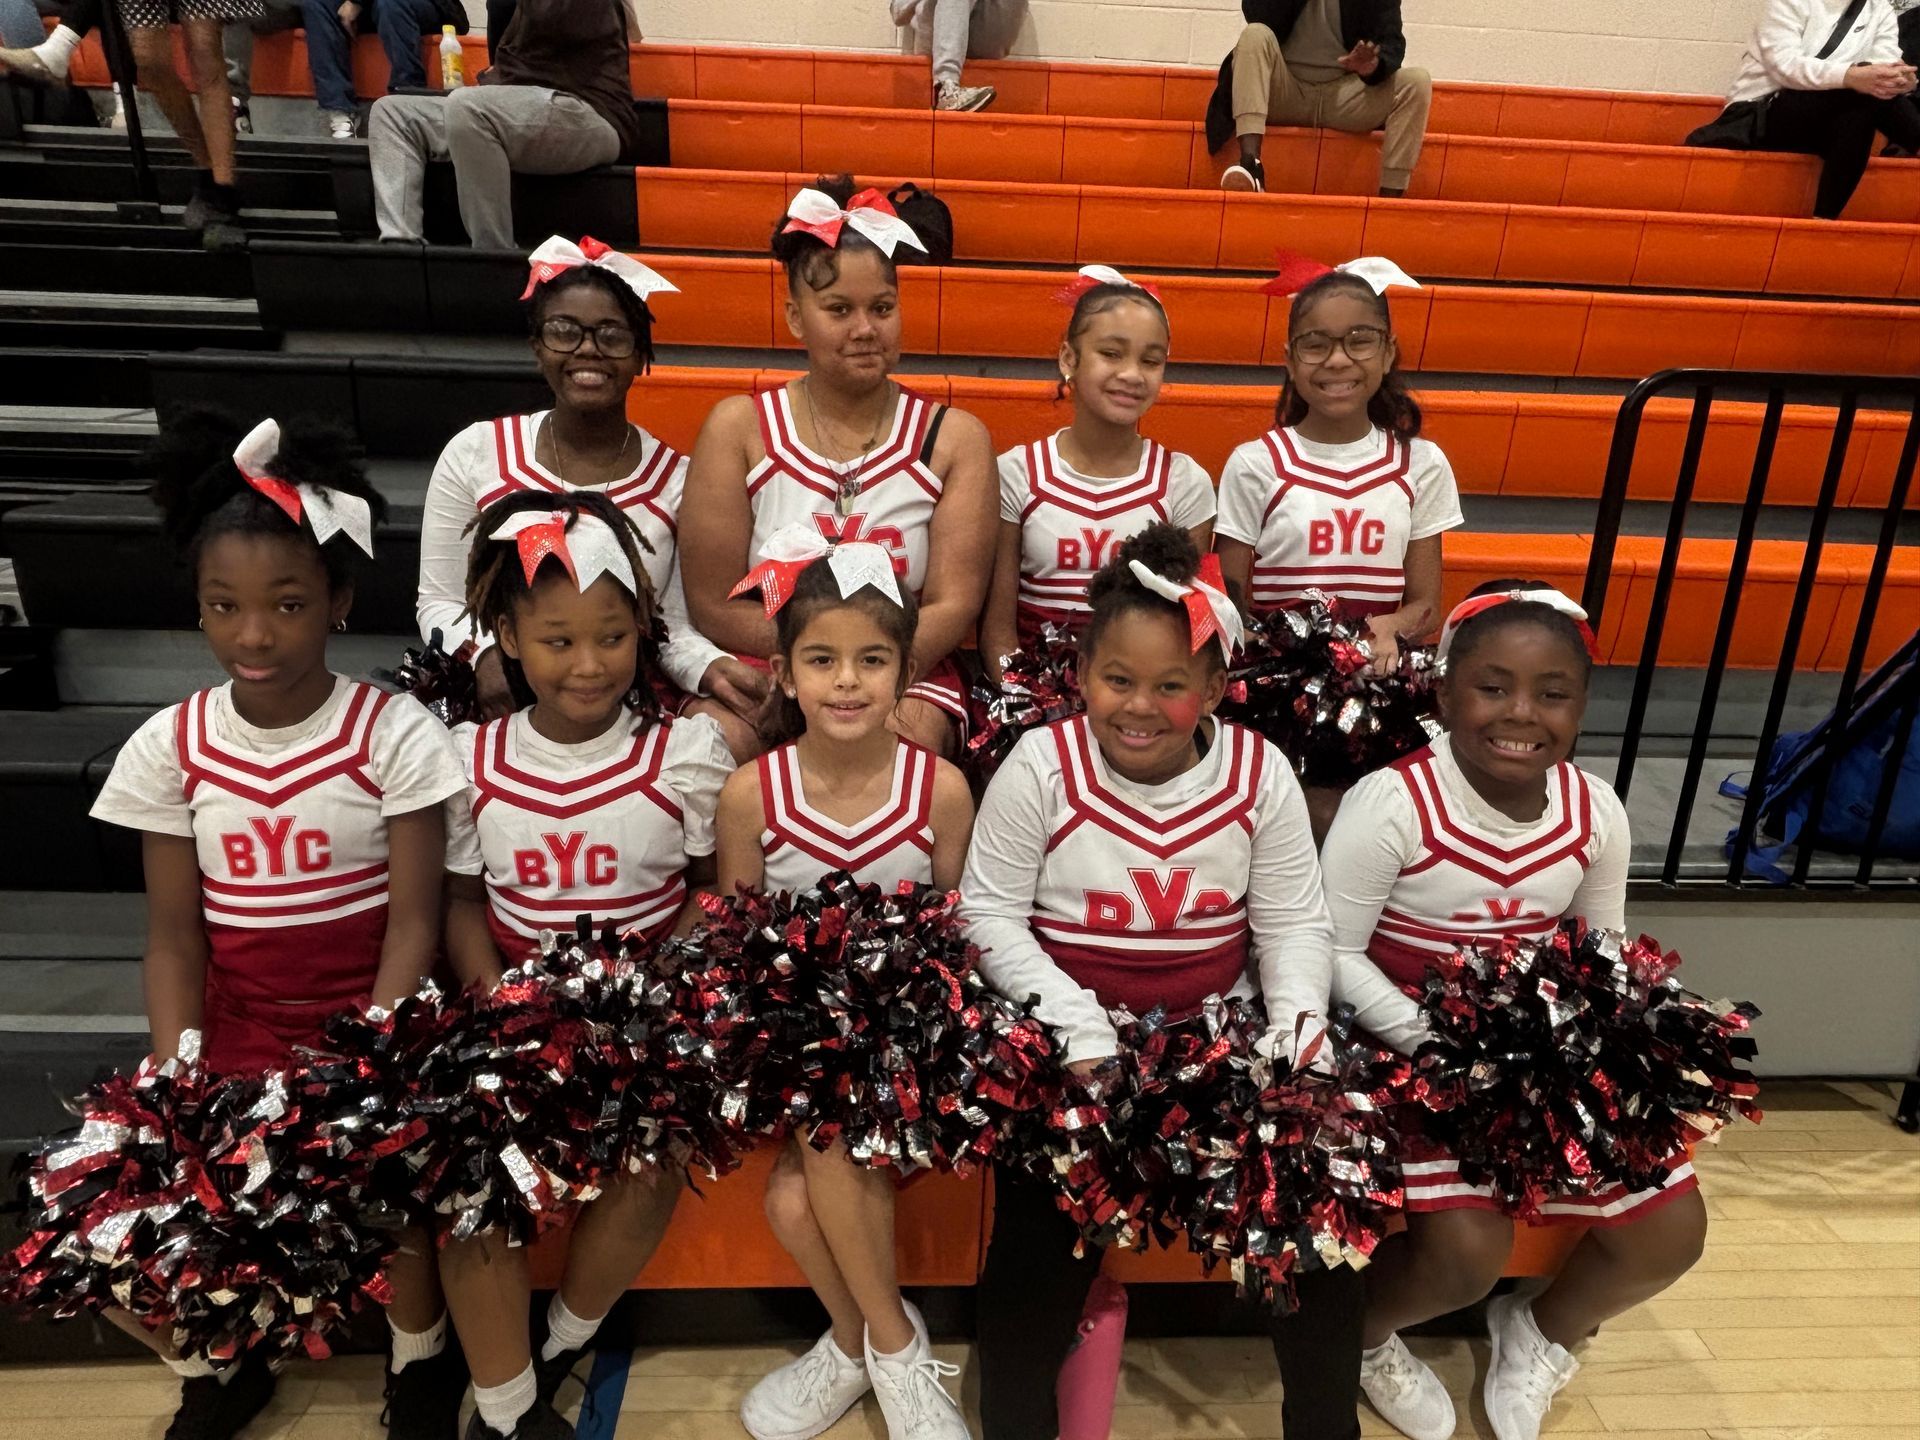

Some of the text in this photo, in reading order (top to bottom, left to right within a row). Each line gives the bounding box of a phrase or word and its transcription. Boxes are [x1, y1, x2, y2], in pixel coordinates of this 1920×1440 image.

[1308, 508, 1385, 556] BYC
[220, 815, 332, 878] BYC
[513, 831, 618, 890] BYC
